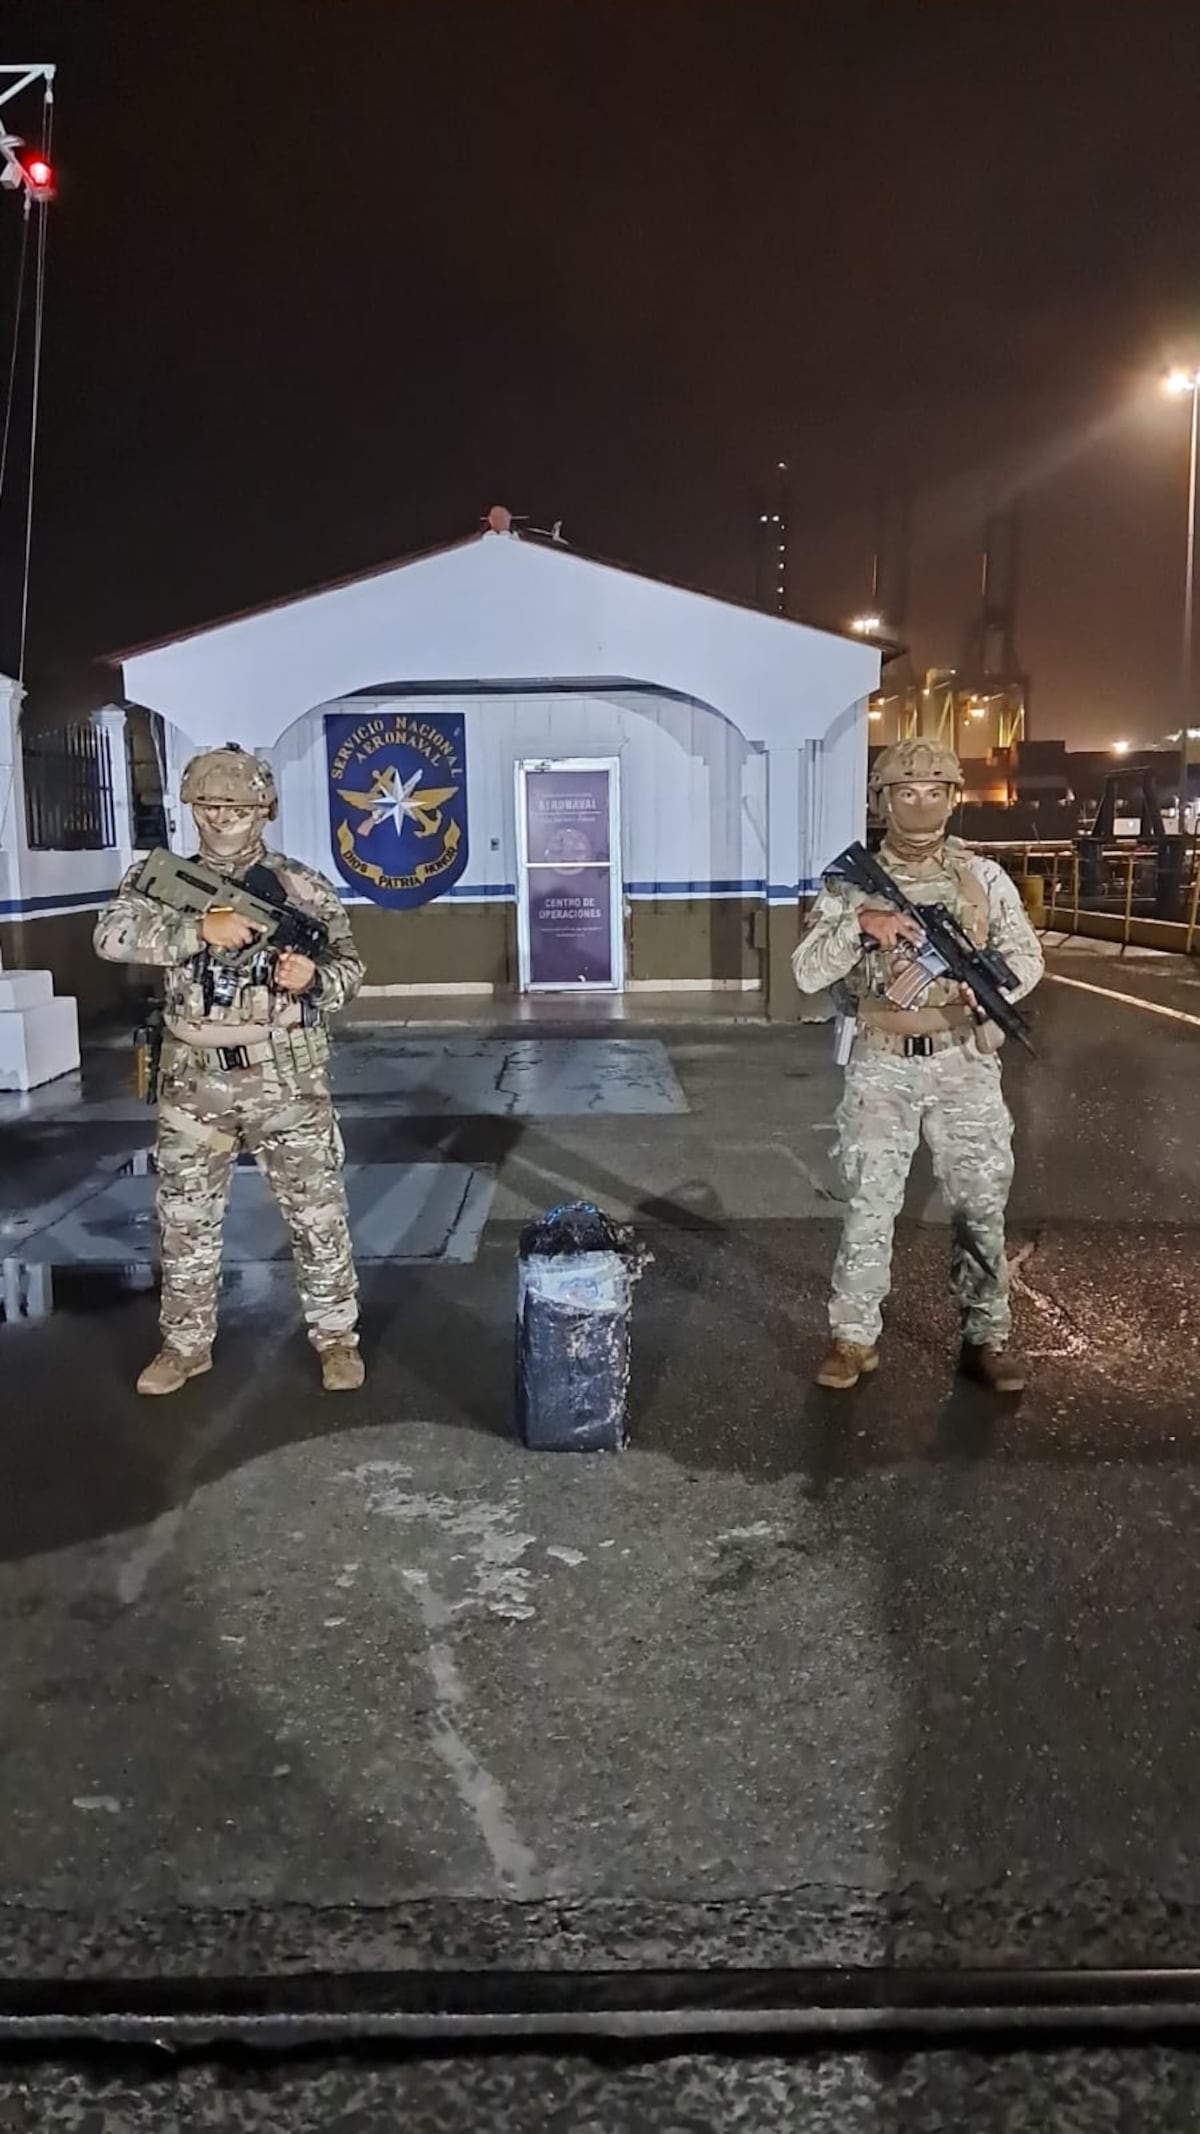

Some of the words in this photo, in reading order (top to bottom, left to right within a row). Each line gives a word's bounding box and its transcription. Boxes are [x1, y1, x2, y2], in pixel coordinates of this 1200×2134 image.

[331, 720, 384, 780] SERVICIO
[395, 716, 463, 778] NACIONAL
[356, 731, 440, 767] AERONAVAL
[343, 850, 368, 873] DIOS
[424, 846, 457, 875] HONOR
[378, 875, 422, 888] PATRIA
[539, 909, 601, 919] OPERACIONES
[545, 898, 581, 908] CENTRO
[582, 897, 596, 907] DE
